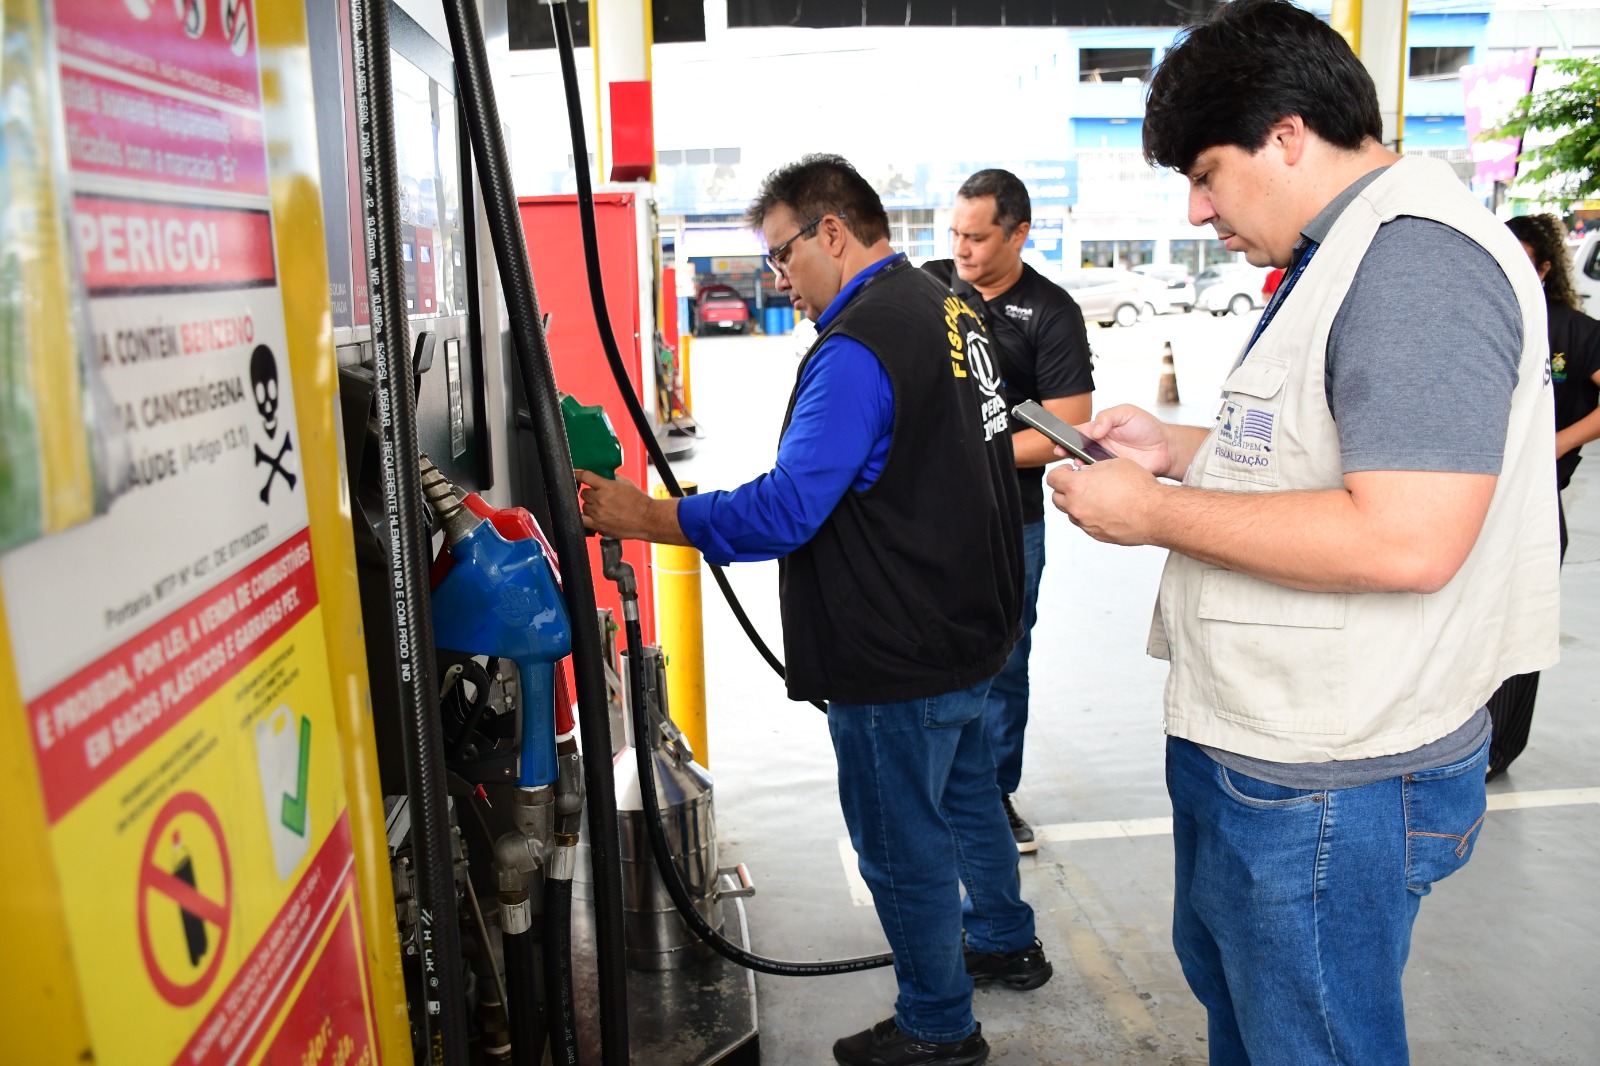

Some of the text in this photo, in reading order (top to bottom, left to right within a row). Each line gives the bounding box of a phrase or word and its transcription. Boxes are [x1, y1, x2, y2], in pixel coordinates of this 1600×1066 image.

[362, 131, 372, 157] DN19
[125, 143, 151, 169] com
[165, 150, 217, 186] marcação
[75, 213, 221, 273] PERIGO!
[370, 266, 380, 286] WP
[115, 317, 180, 366] CONTÉM
[180, 315, 255, 356] BENZENO
[376, 341, 388, 380] 1520PSI
[141, 376, 246, 430] CANCERÍGENA
[380, 387, 392, 427] 105BAR
[1214, 446, 1270, 467] FISCALIZAÇÃO
[384, 440, 399, 515] REQUERENTE
[389, 514, 403, 569] HLEMMAN
[393, 571, 404, 589] IND
[395, 591, 405, 599] E
[104, 592, 153, 630] Portaria
[396, 600, 407, 626] COM
[35, 540, 311, 750] É PROIBIDA, POR LEI, A VENDA DE COMBUSTÍVEIS
[399, 628, 410, 659] PROD
[84, 726, 114, 770] EM
[111, 690, 162, 749] SACOS
[160, 643, 226, 711] PLÁSTICOS
[224, 634, 236, 661] E
[234, 600, 283, 653] GARRAFAS
[402, 663, 412, 683] IND
